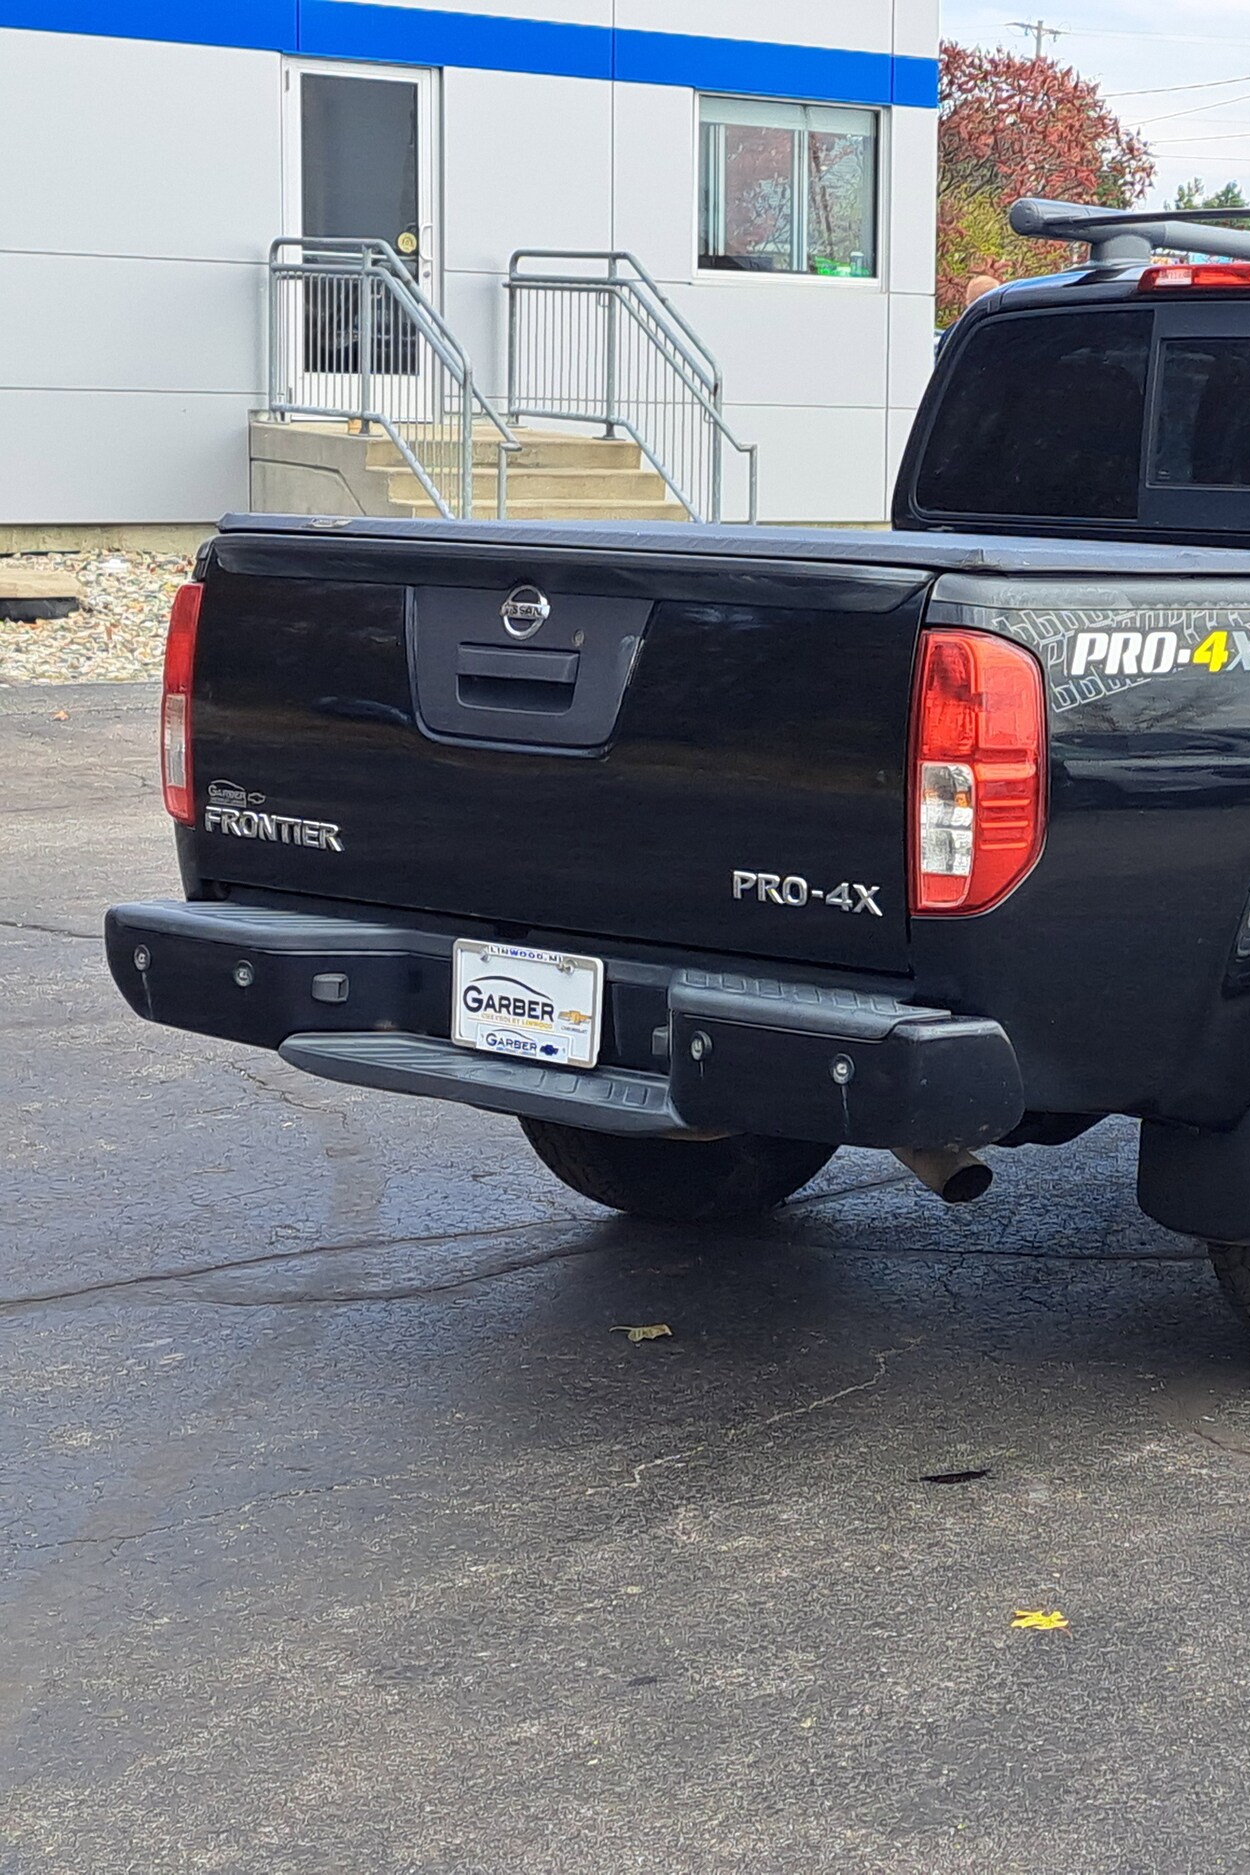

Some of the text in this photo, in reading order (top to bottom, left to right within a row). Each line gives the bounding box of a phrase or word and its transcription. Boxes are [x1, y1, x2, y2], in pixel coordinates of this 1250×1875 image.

[205, 805, 345, 852] FRONTIER
[732, 869, 883, 917] PRO-4X
[462, 984, 555, 1023] GARBER
[485, 1032, 538, 1052] GARBER
